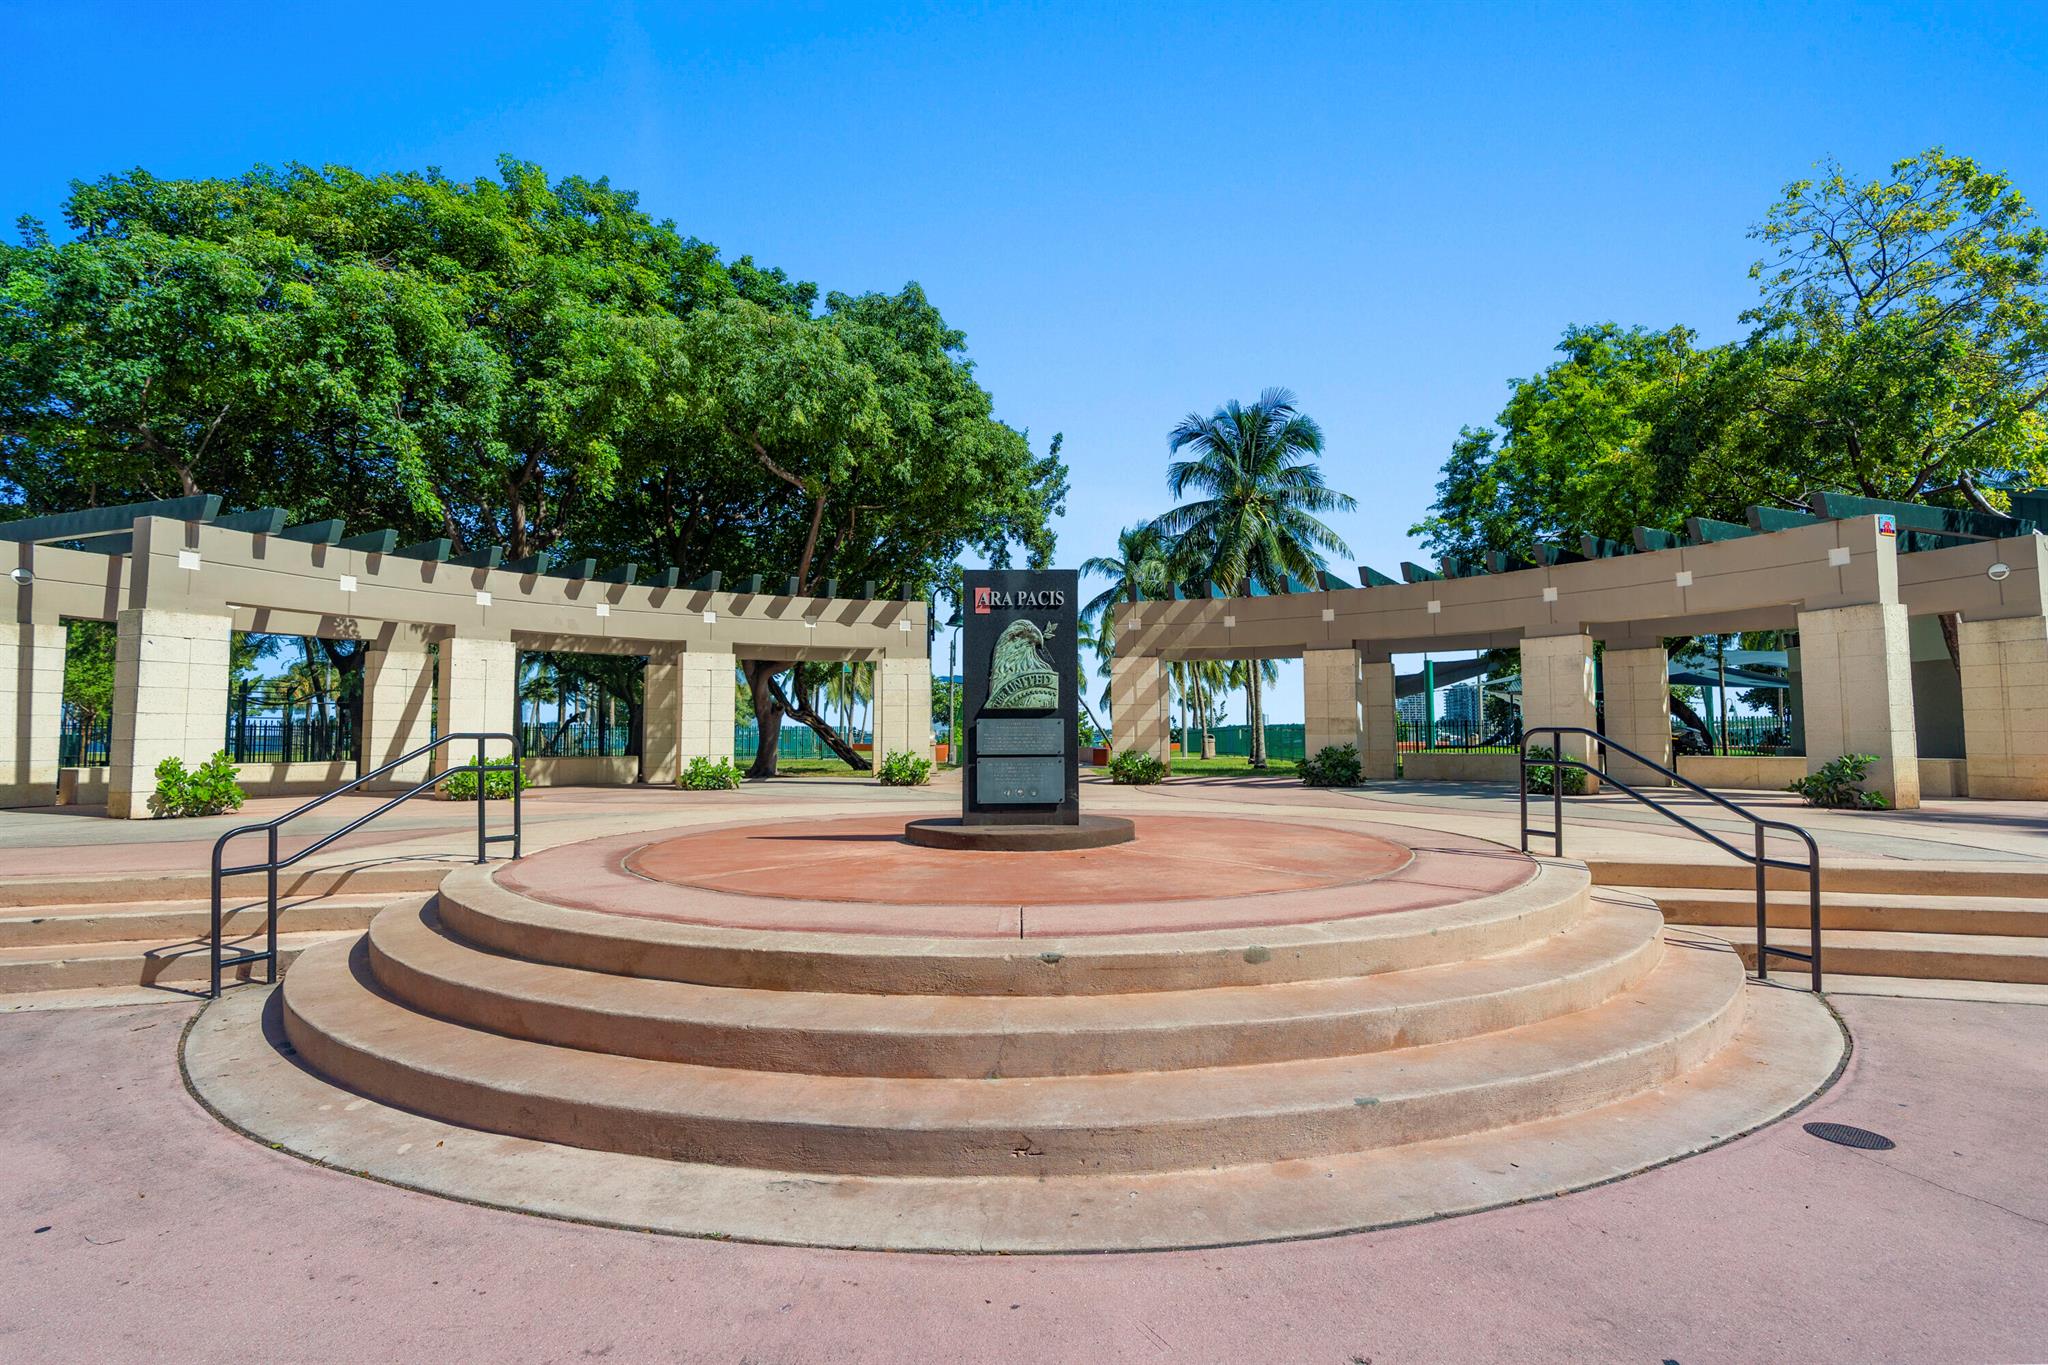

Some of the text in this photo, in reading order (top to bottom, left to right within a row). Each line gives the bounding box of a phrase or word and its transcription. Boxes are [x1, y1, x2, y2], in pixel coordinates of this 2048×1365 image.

[978, 590, 1065, 606] ARA PACIS
[1005, 674, 1054, 694] UNITED
